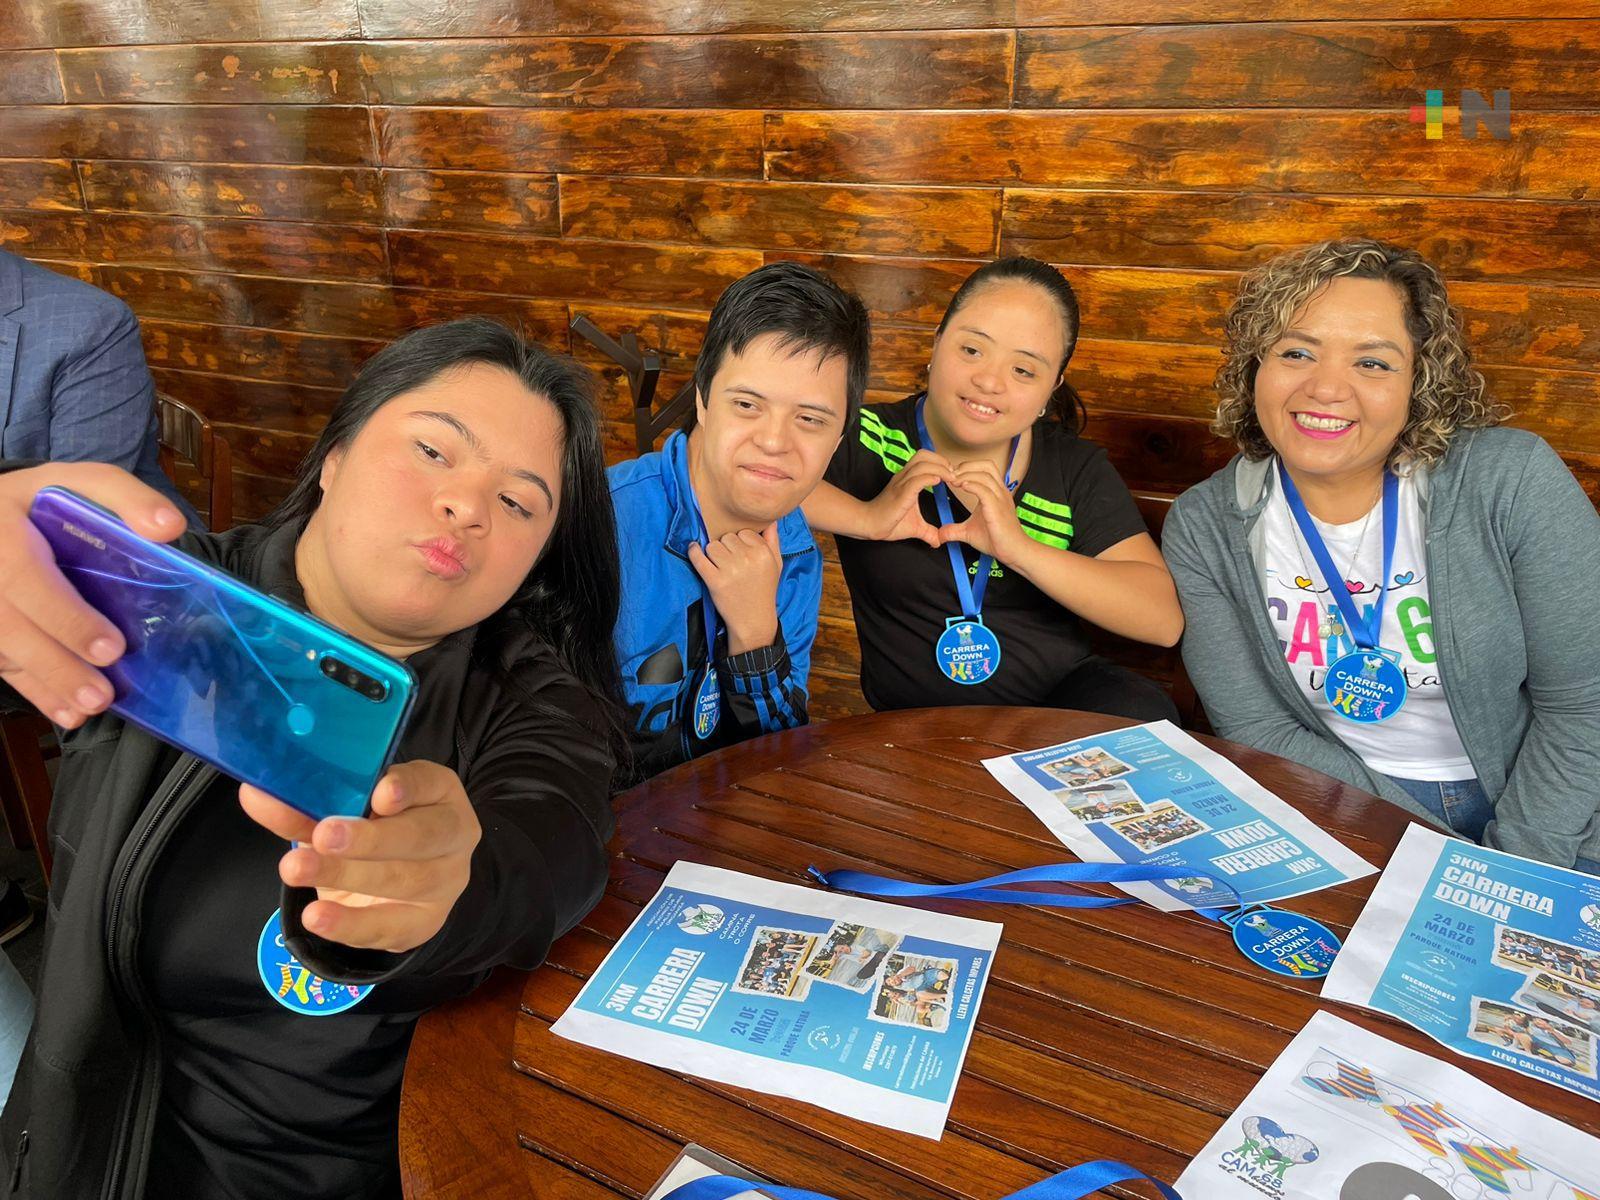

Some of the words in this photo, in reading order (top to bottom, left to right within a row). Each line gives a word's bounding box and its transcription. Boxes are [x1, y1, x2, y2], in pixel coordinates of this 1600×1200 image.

[943, 643, 990, 655] CARRERA
[953, 652, 983, 661] DOWN
[1336, 670, 1394, 694] CARRERA
[1343, 683, 1383, 700] DOWN
[1192, 794, 1229, 809] MARZO
[1205, 808, 1222, 818] DE
[1220, 804, 1237, 815] 24
[1214, 822, 1279, 849] DOWN
[1212, 840, 1303, 876] CARRERA
[1285, 857, 1322, 875] 3KM
[1449, 853, 1488, 874] 3KM
[1435, 882, 1511, 920] DOWN
[1442, 866, 1554, 915] CARRERA
[719, 912, 739, 940] CAMINA
[727, 916, 745, 940] TROTA
[739, 913, 756, 938] CORRE
[1424, 921, 1475, 946] MARZO
[1432, 913, 1452, 927] 24
[1456, 921, 1475, 934] DE
[1252, 925, 1308, 954] CARRERA
[1271, 936, 1311, 957] DOWN
[1409, 931, 1441, 950] PARQUE
[1444, 946, 1478, 965] NATURA
[968, 957, 983, 978] IMPARES
[631, 947, 701, 1020] CARRERA
[960, 977, 976, 1003] CALCETAS
[605, 983, 639, 1012] 3KM
[667, 976, 724, 1031] DOWN
[739, 1006, 758, 1020] DE
[956, 1003, 969, 1019] LLEVA
[730, 1020, 750, 1036] 24
[748, 1008, 779, 1044] MARZO
[780, 1032, 800, 1057] PARQUE
[862, 1031, 885, 1071] INSCRIPCIONES
[1492, 1049, 1517, 1065] LLEVA
[1519, 1058, 1562, 1081] CALCETAS
[1221, 1151, 1256, 1177] CAM
[1261, 1173, 1283, 1188] 68
